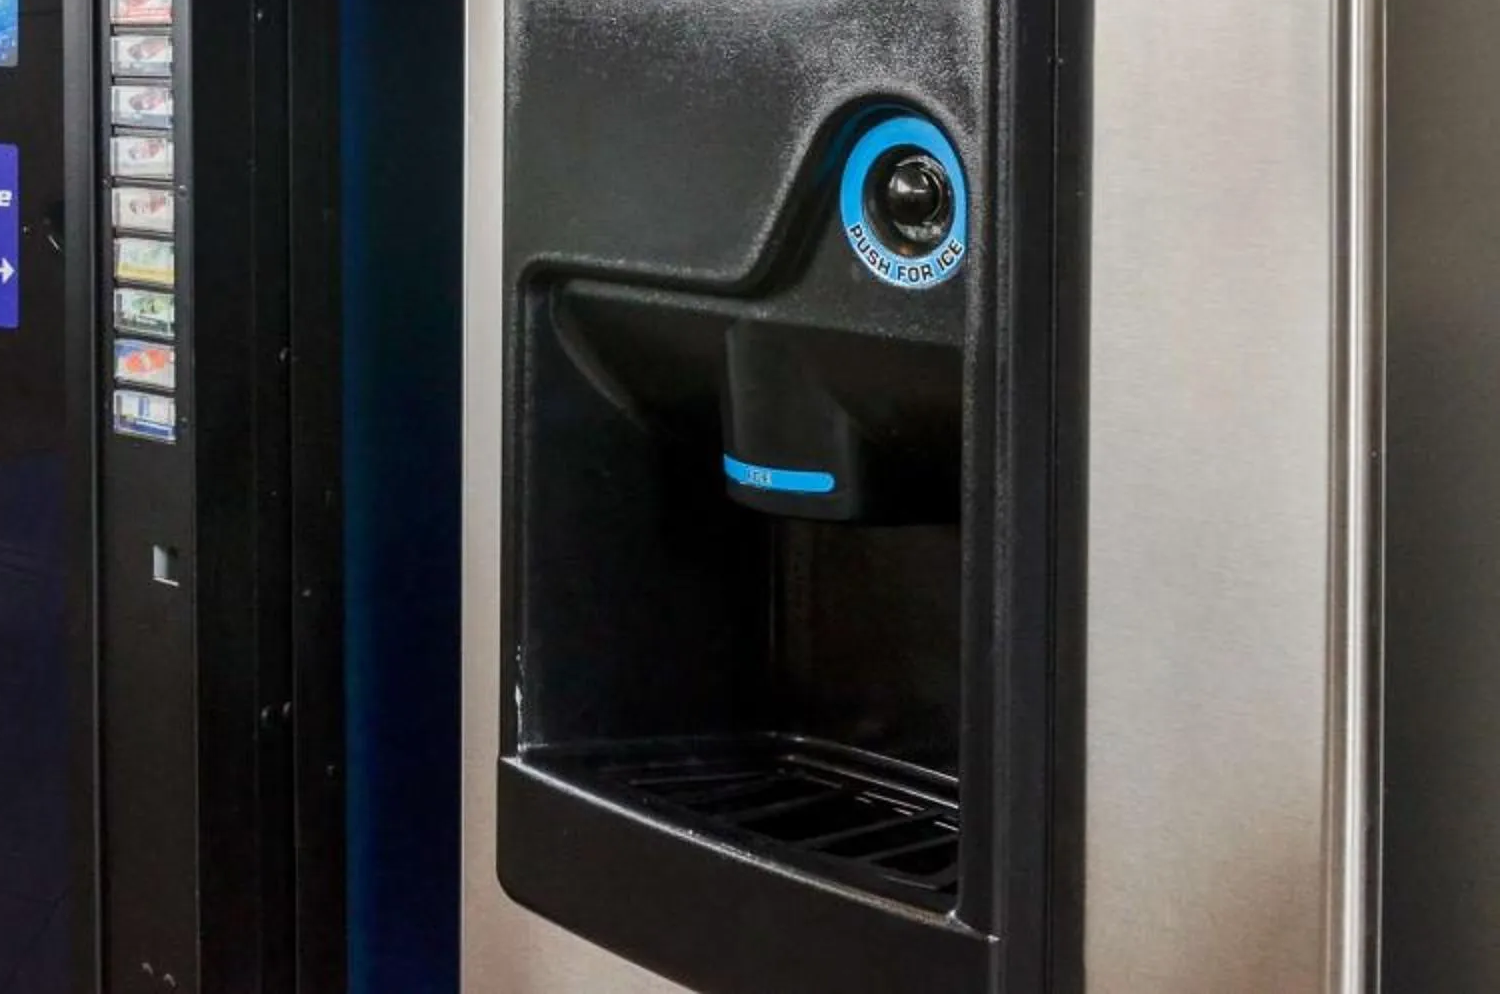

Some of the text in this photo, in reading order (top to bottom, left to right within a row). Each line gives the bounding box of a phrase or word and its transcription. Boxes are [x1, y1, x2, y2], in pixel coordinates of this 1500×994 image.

[849, 224, 964, 283] PUSH FOR ICE
